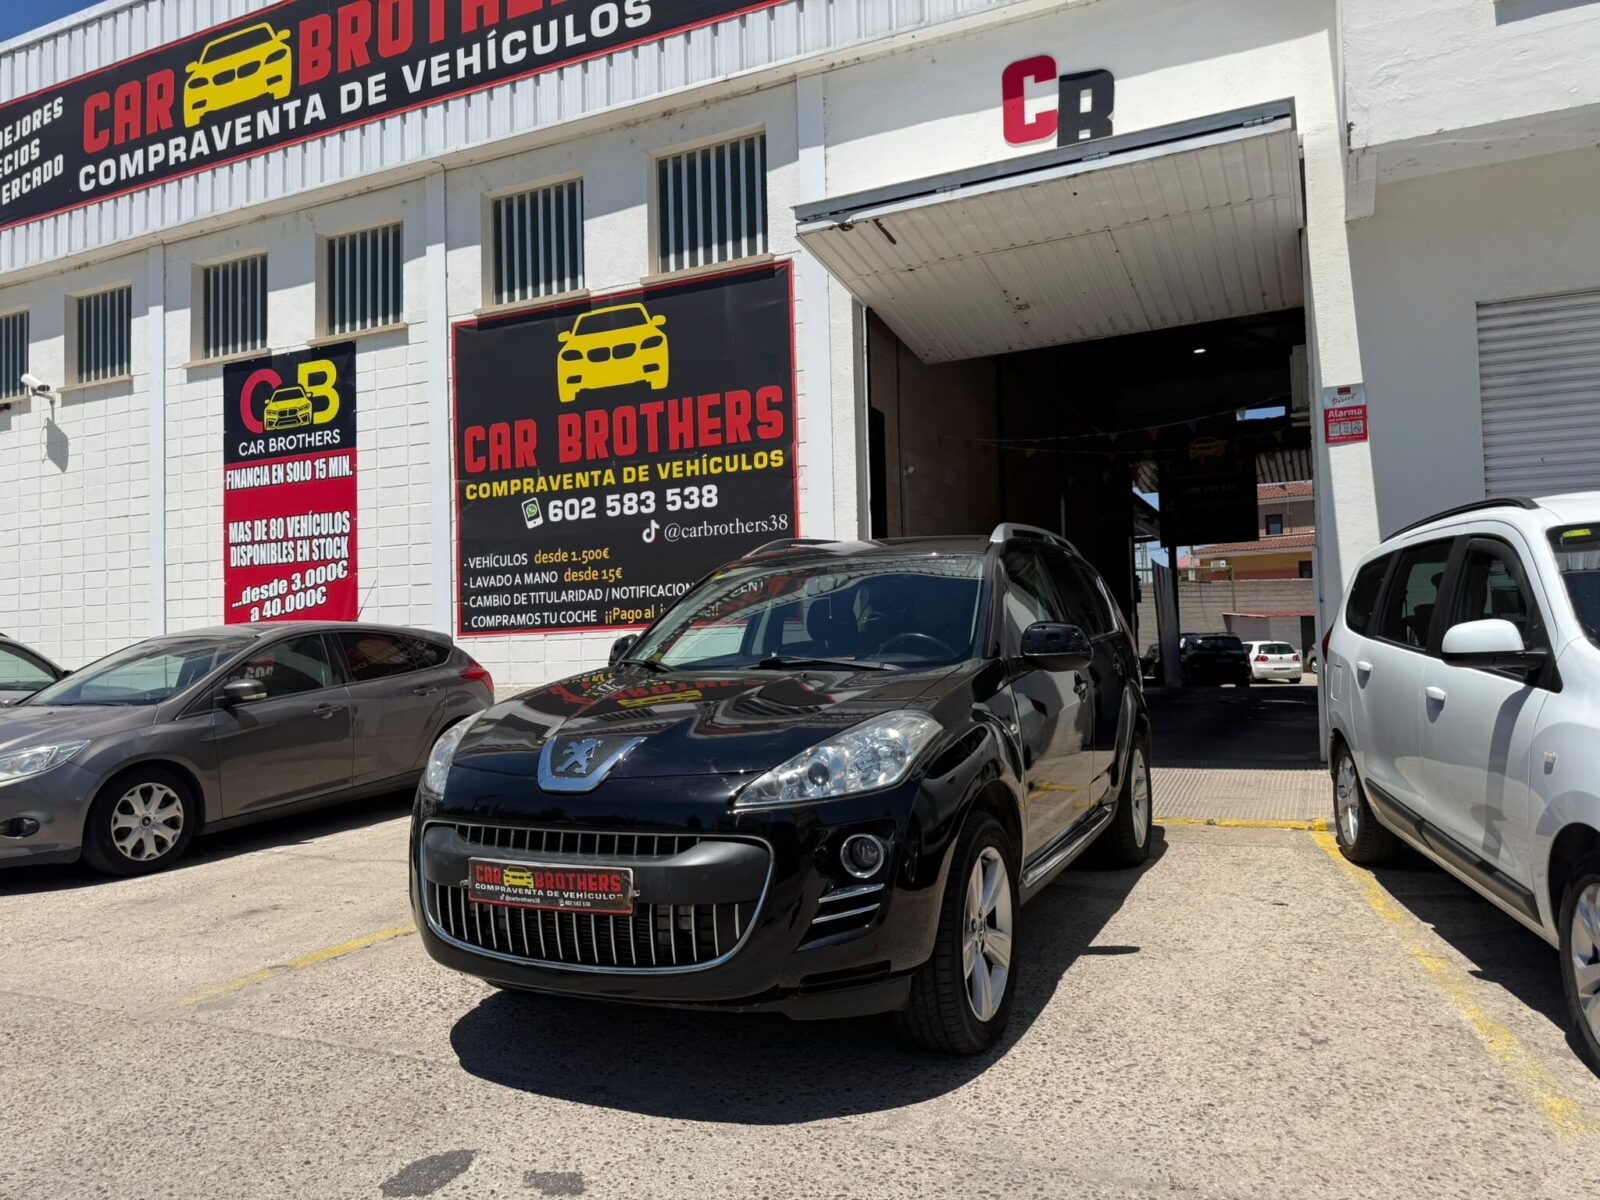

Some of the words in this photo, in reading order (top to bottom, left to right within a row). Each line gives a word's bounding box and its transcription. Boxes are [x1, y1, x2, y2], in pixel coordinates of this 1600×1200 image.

[83, 69, 174, 153] CAR
[299, 0, 567, 86] BROT
[79, 93, 325, 192] COMPRAVENTA
[340, 72, 387, 114] DE
[401, 0, 652, 93] VEHÍCULOS
[0, 97, 63, 150] EJORES
[1328, 408, 1363, 418] Alarma
[239, 440, 265, 456] CAR
[269, 429, 341, 452] BROTHERS
[464, 418, 537, 473] CAR
[558, 385, 784, 463] BROTHERS
[226, 465, 270, 490] FINANCIA
[272, 463, 285, 484] EN
[286, 460, 312, 483] SOLO
[314, 458, 326, 479] 15
[328, 455, 353, 478] MIN.
[465, 470, 616, 500] COMPRAVENTA
[623, 465, 650, 483] DE
[657, 449, 784, 480] VEHÍCULOS
[548, 497, 596, 522] 602
[606, 491, 656, 517] 583
[666, 484, 718, 512] 538
[228, 520, 252, 544] MAS
[254, 519, 267, 541] DE
[269, 517, 285, 539] 80
[286, 510, 350, 538] VEHÍCULOS
[664, 513, 789, 541] @carbrothers38
[230, 541, 295, 567] DISPONIBLES
[297, 539, 309, 562] EN
[312, 536, 349, 560] STOCK
[468, 553, 528, 569] VEHÍCULOS
[534, 548, 568, 565] desde
[571, 548, 609, 564] 1.500€
[291, 560, 348, 591] 3.000€
[469, 574, 512, 588] LAVADO
[514, 573, 522, 585] A
[524, 571, 558, 585] MANO
[564, 567, 599, 583] desde
[602, 567, 623, 583] 15€
[250, 607, 260, 622] a
[262, 586, 327, 618] 40.000€
[469, 594, 510, 608] CAMBIO
[514, 592, 528, 605] DE
[529, 589, 603, 604] TITULARIDAD
[471, 613, 541, 628] COMPRAMOS
[543, 612, 557, 624] TU
[559, 610, 597, 624] COCHE
[644, 604, 655, 619] al
[475, 882, 544, 896] COMPRAVENTA
[476, 866, 501, 883] CAR
[535, 874, 621, 892] BROTHERS
